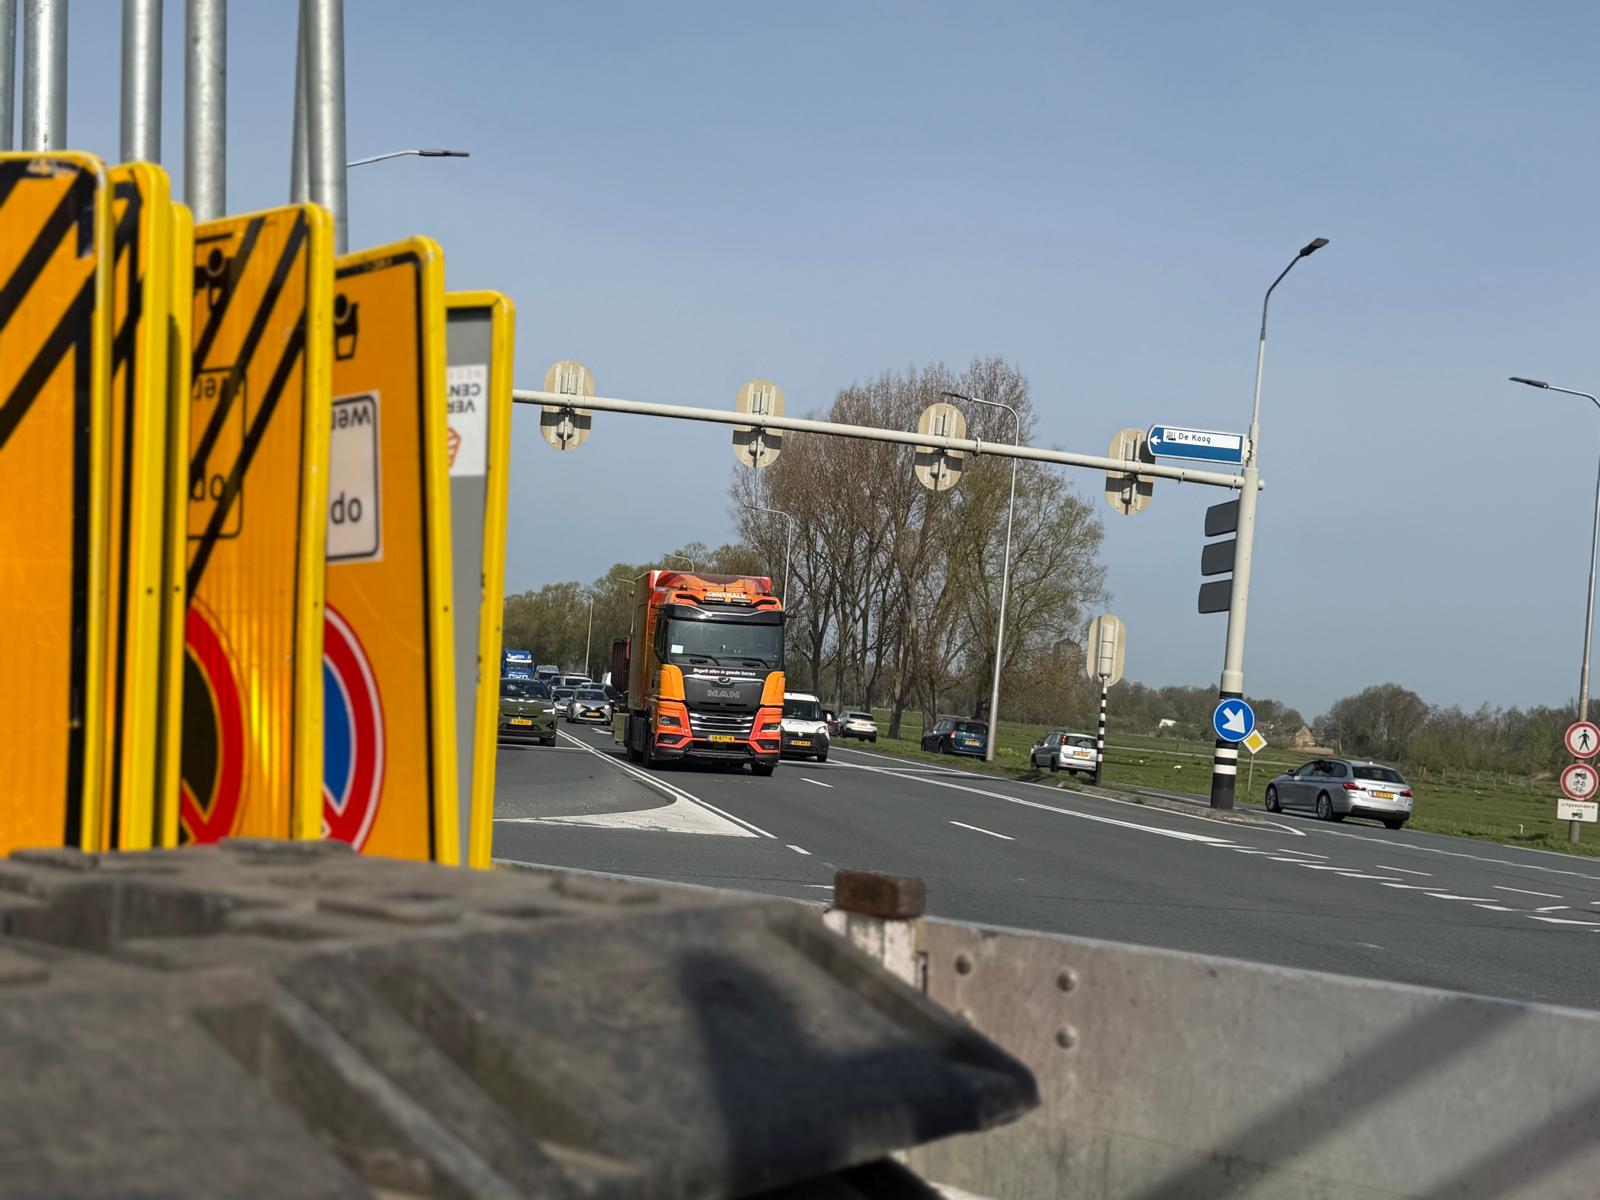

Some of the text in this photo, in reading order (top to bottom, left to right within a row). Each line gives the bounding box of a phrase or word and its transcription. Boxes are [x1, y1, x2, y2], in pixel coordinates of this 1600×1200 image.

[447, 382, 482, 397] CEN
[1178, 432, 1212, 445] De Koog
[330, 491, 362, 525] op
[707, 689, 741, 699] MAN
